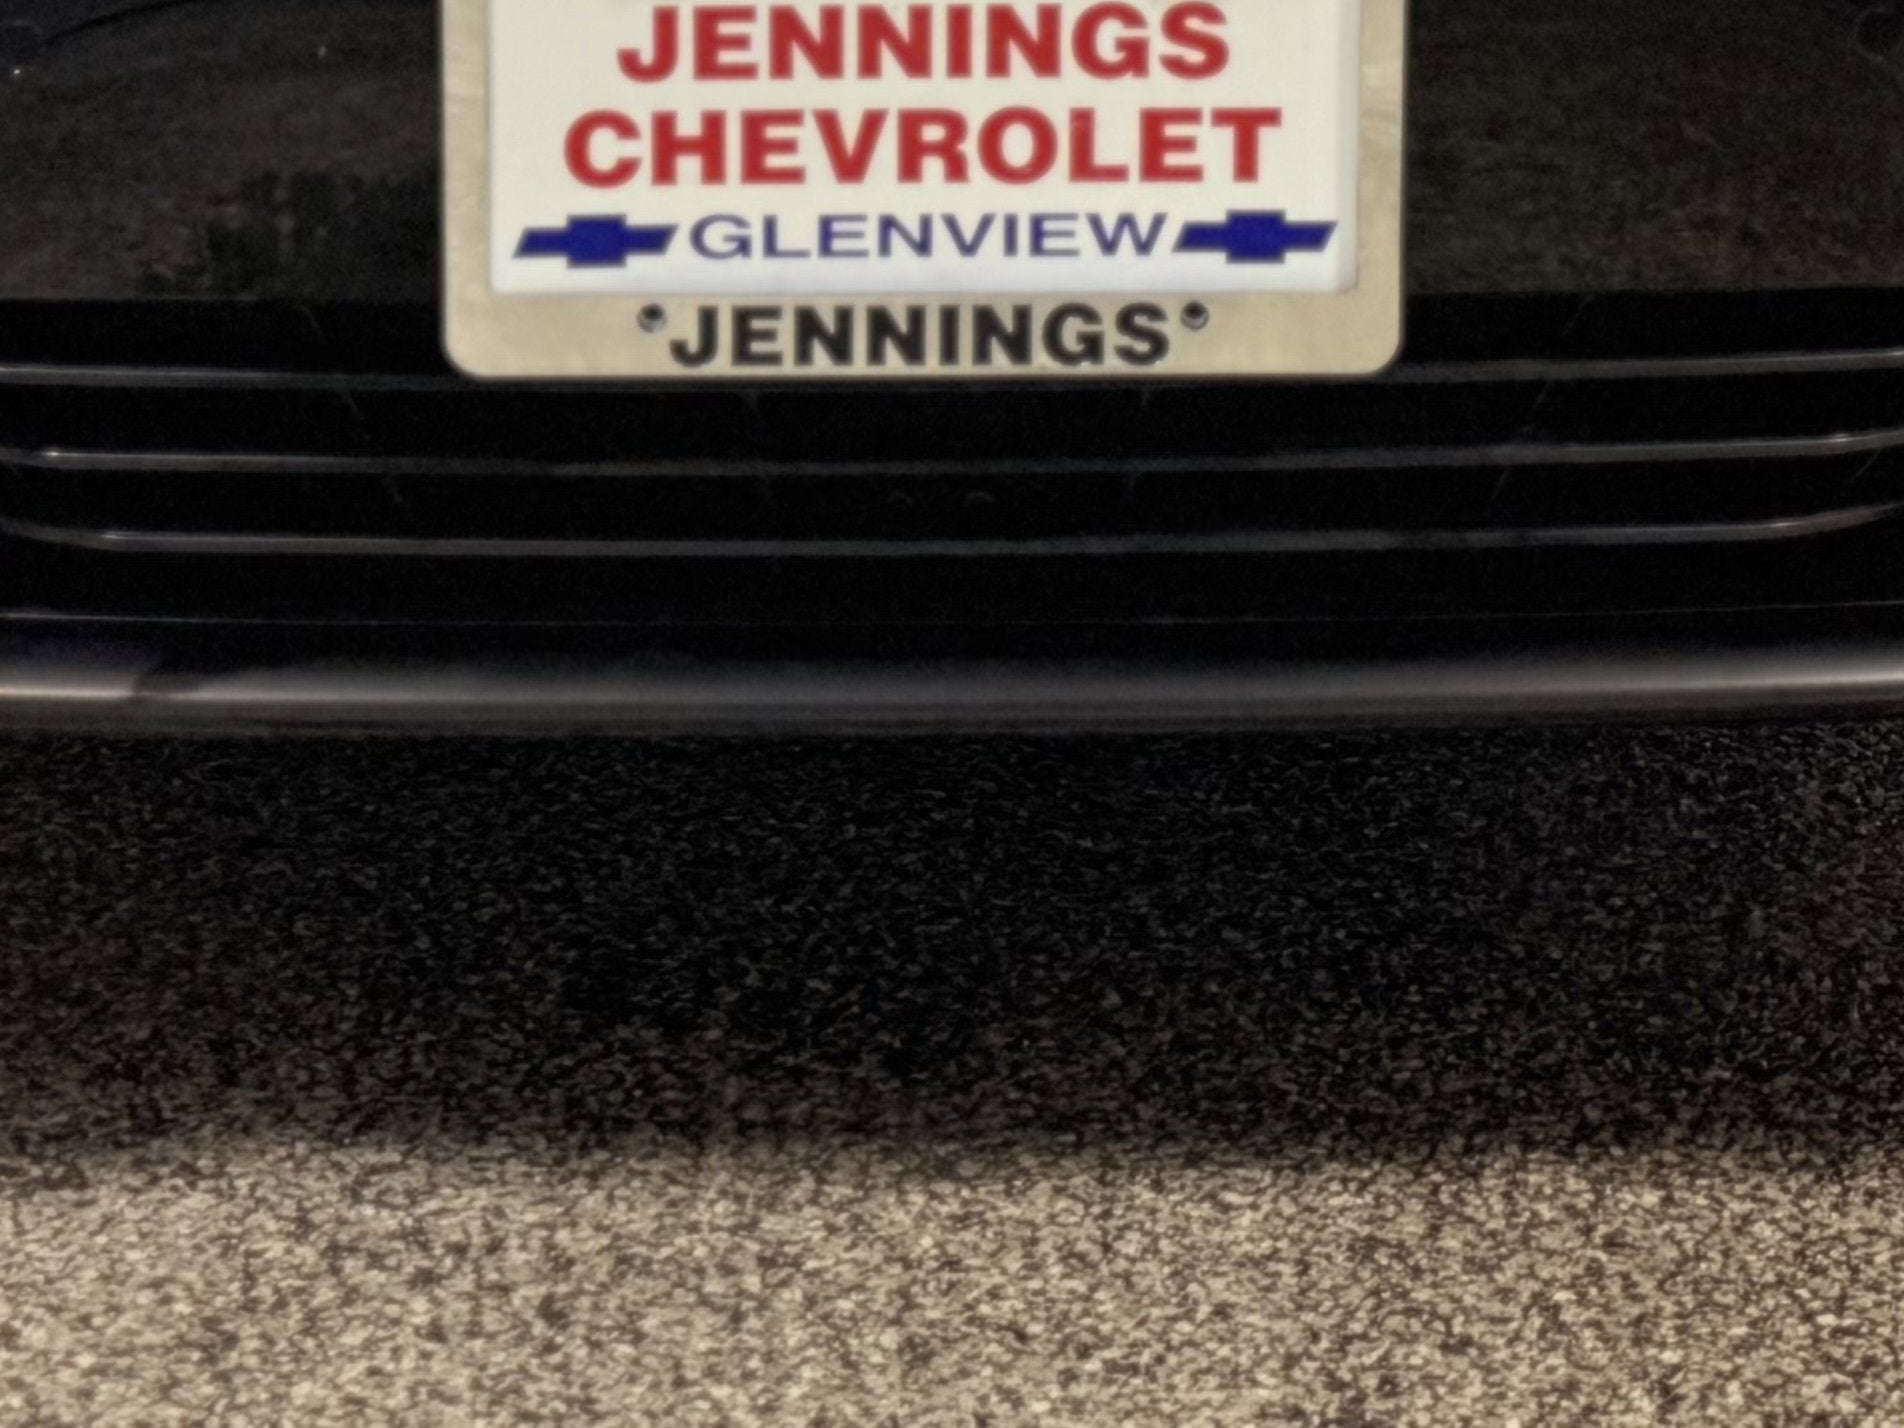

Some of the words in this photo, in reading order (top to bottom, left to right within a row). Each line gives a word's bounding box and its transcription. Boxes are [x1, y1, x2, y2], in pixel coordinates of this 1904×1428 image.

[615, 1, 1230, 82] JENNINGS
[563, 107, 1283, 188] CHEVROLET
[689, 211, 1169, 260] GLENVIEW
[669, 302, 1171, 367] JENNINGS
